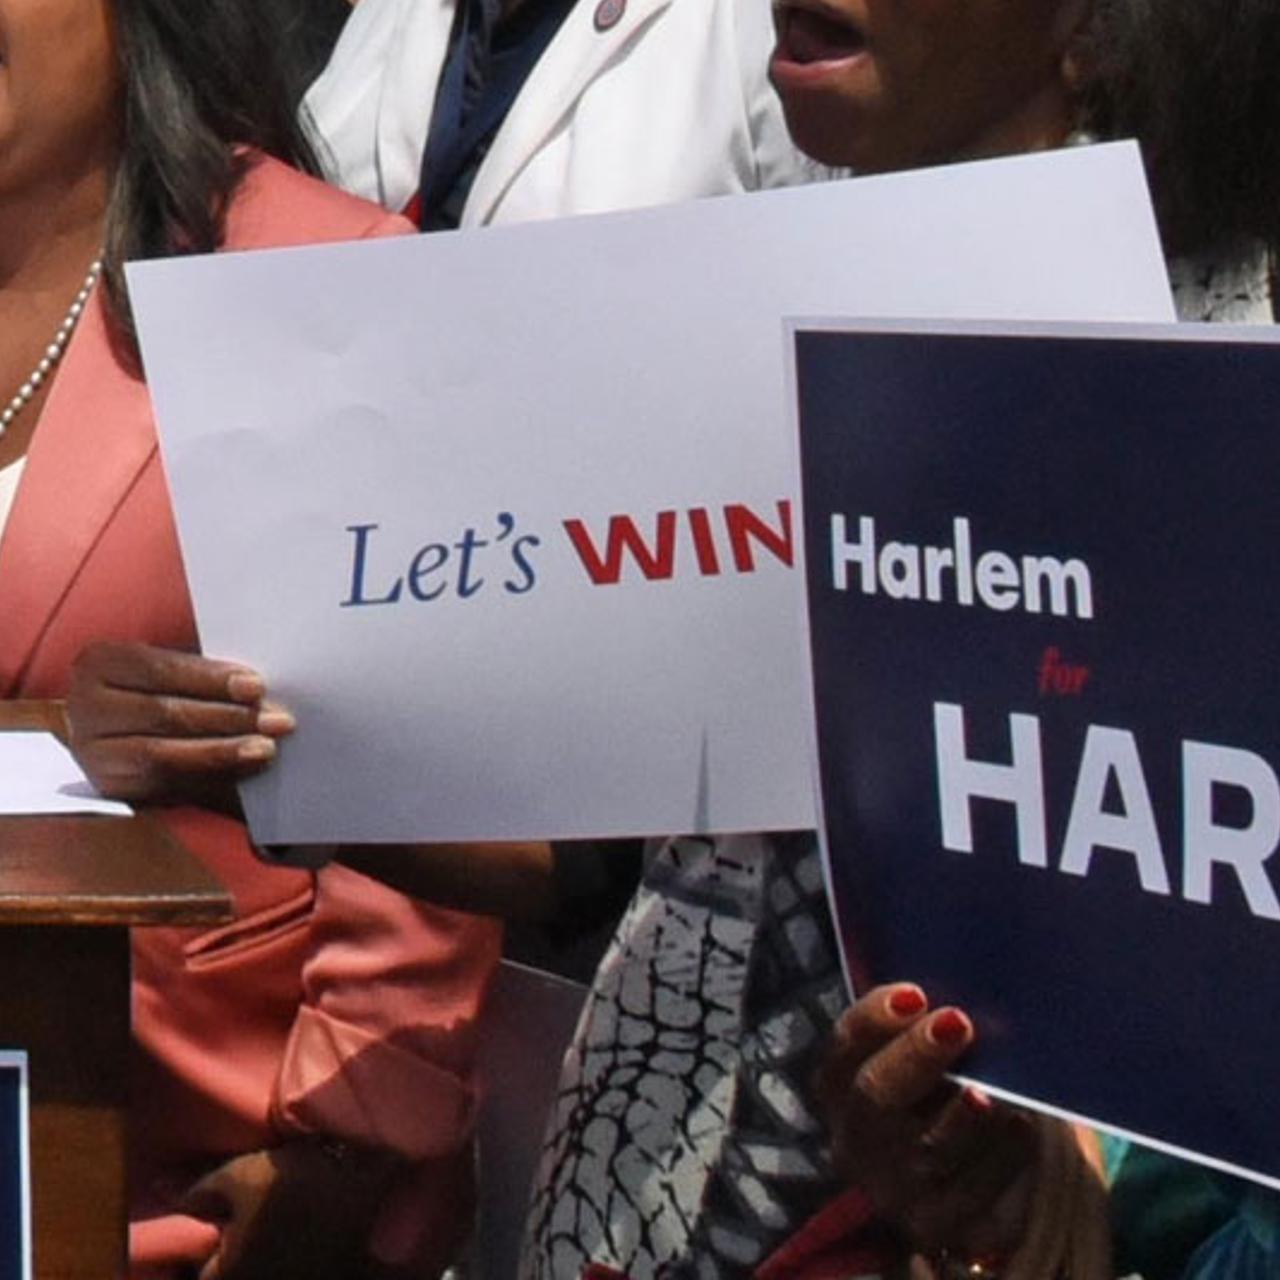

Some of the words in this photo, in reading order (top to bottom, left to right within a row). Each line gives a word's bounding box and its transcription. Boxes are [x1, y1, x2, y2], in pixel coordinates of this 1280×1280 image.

[562, 500, 794, 585] WIN
[830, 513, 1093, 619] Harlem
[1040, 647, 1089, 695] for
[933, 702, 1280, 922] HAR
